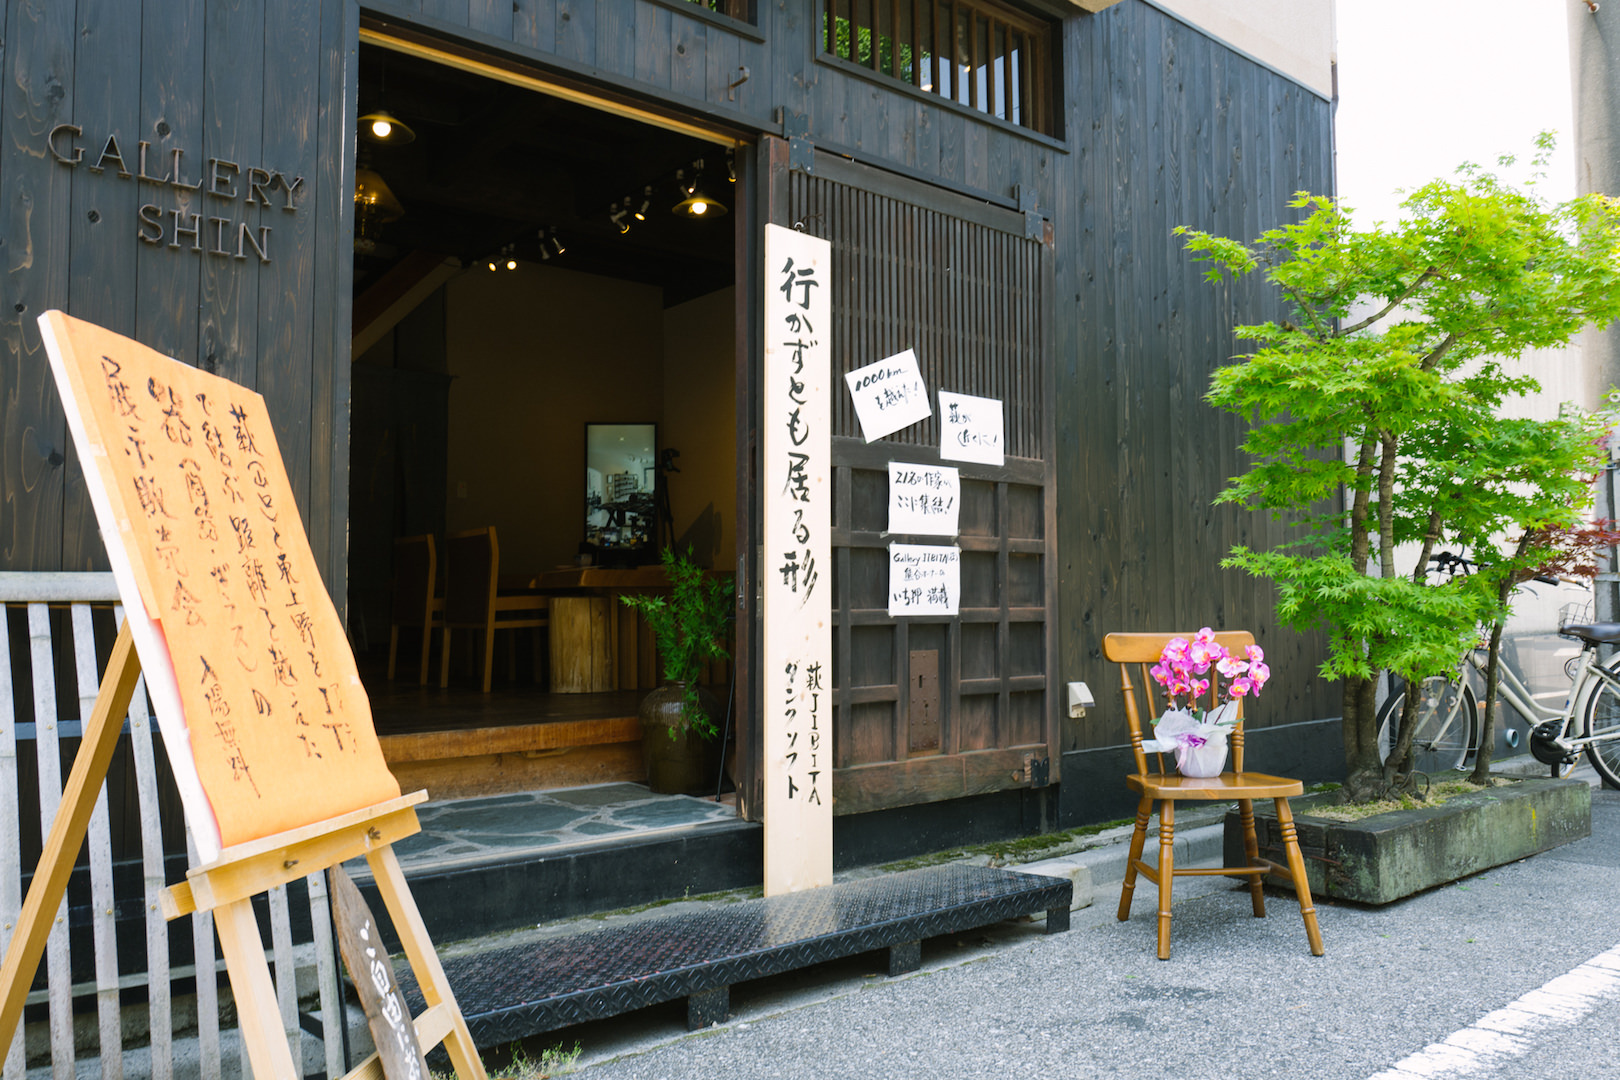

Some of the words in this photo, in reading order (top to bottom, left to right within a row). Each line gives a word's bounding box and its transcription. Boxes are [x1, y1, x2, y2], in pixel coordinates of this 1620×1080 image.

[49, 123, 304, 211] GALLERY
[137, 203, 273, 264] SHIN
[779, 257, 819, 612] 行かずとも居る形
[784, 659, 800, 799] ダンクソフト
